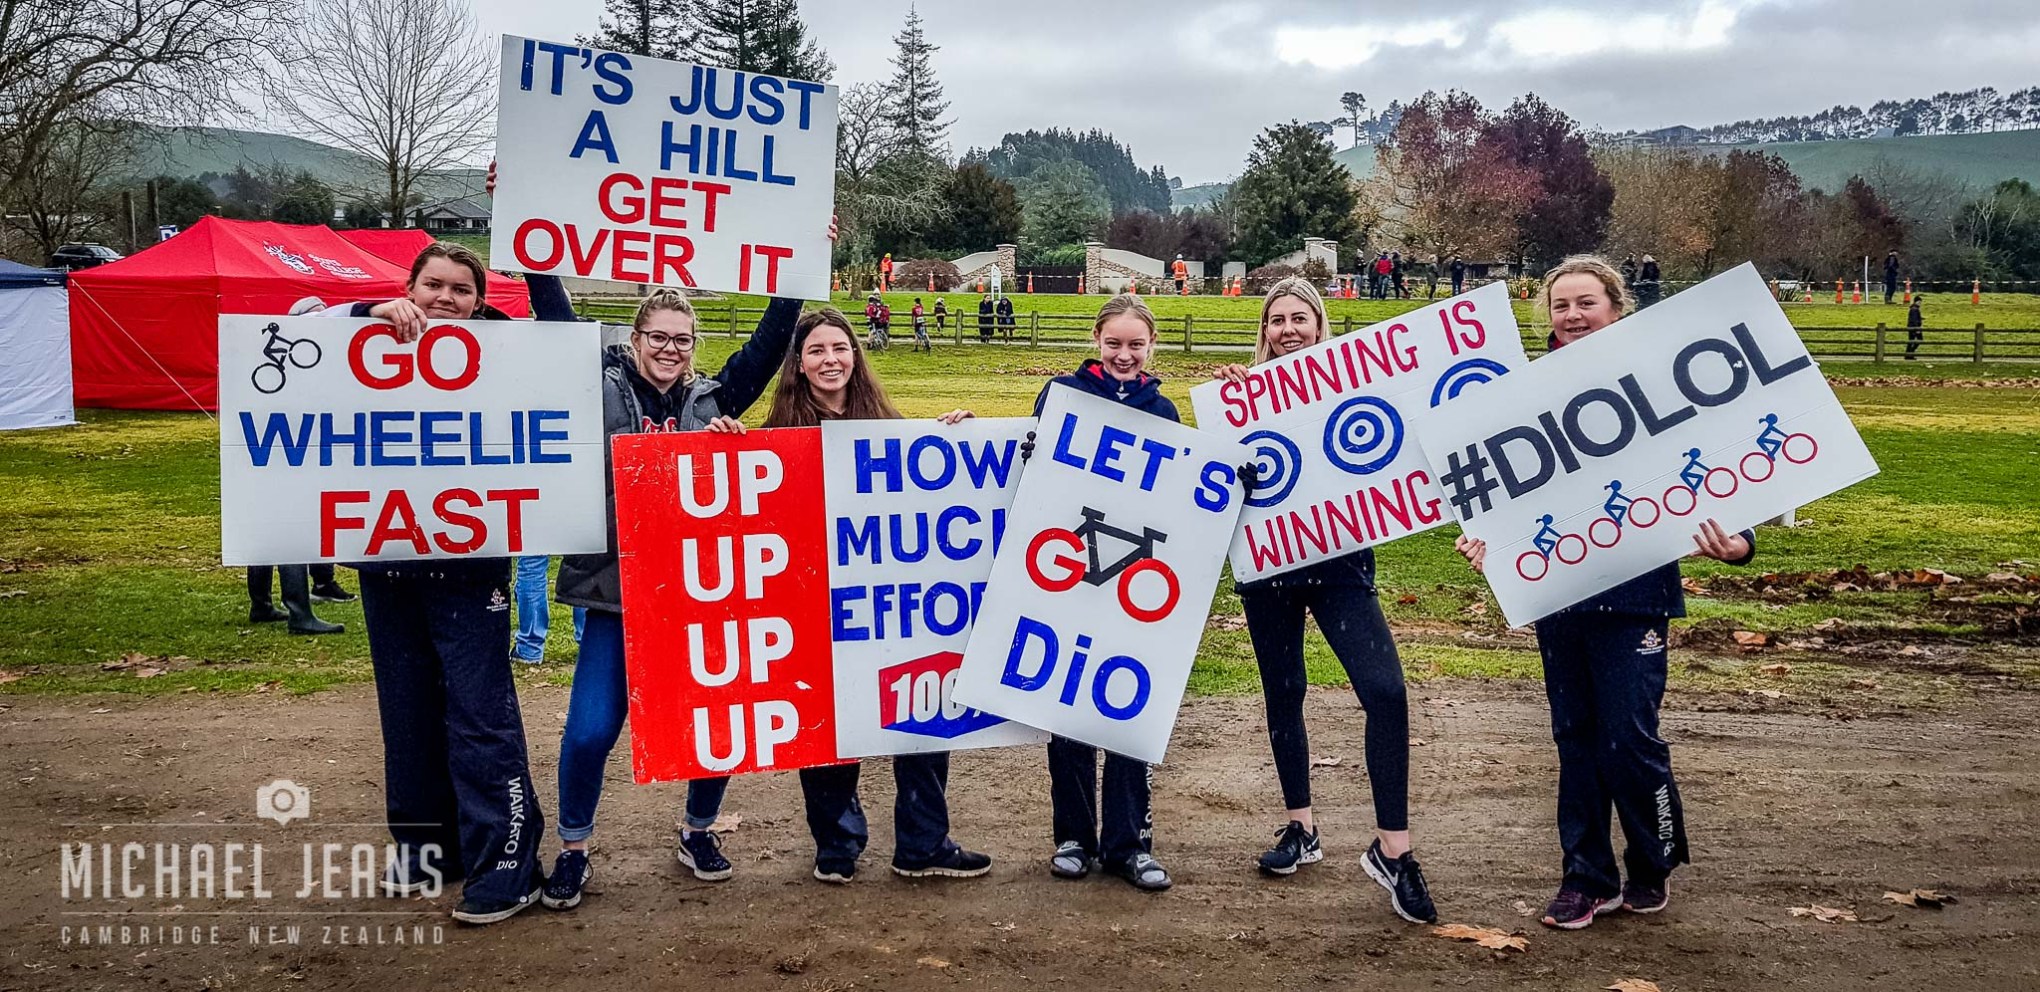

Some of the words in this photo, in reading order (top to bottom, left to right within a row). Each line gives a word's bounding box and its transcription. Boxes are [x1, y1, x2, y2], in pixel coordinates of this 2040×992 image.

[518, 39, 634, 104] IT'S
[669, 65, 825, 131] JUST
[569, 110, 619, 163] A
[660, 120, 796, 186] HILL
[598, 172, 732, 232] GET
[513, 218, 696, 287] OVER
[739, 243, 793, 294] IT
[347, 323, 482, 391] GO
[1219, 323, 1420, 428] SPINNING
[1439, 300, 1486, 355] IS
[239, 410, 573, 466] WHEELIE
[1440, 322, 1812, 520] #DIOLOL
[677, 449, 784, 519] UP
[854, 434, 1018, 494] HOW
[1052, 411, 1236, 514] LET'S
[320, 488, 540, 558] FAST
[1244, 469, 1443, 572] WINNING
[682, 533, 790, 602] UP
[1025, 527, 1181, 623] GO
[687, 616, 795, 687] UP
[693, 700, 800, 772] UP
[504, 776, 525, 854] WAIKATO
[1654, 784, 1675, 840] WAIKATO
[496, 860, 518, 870] DIO
